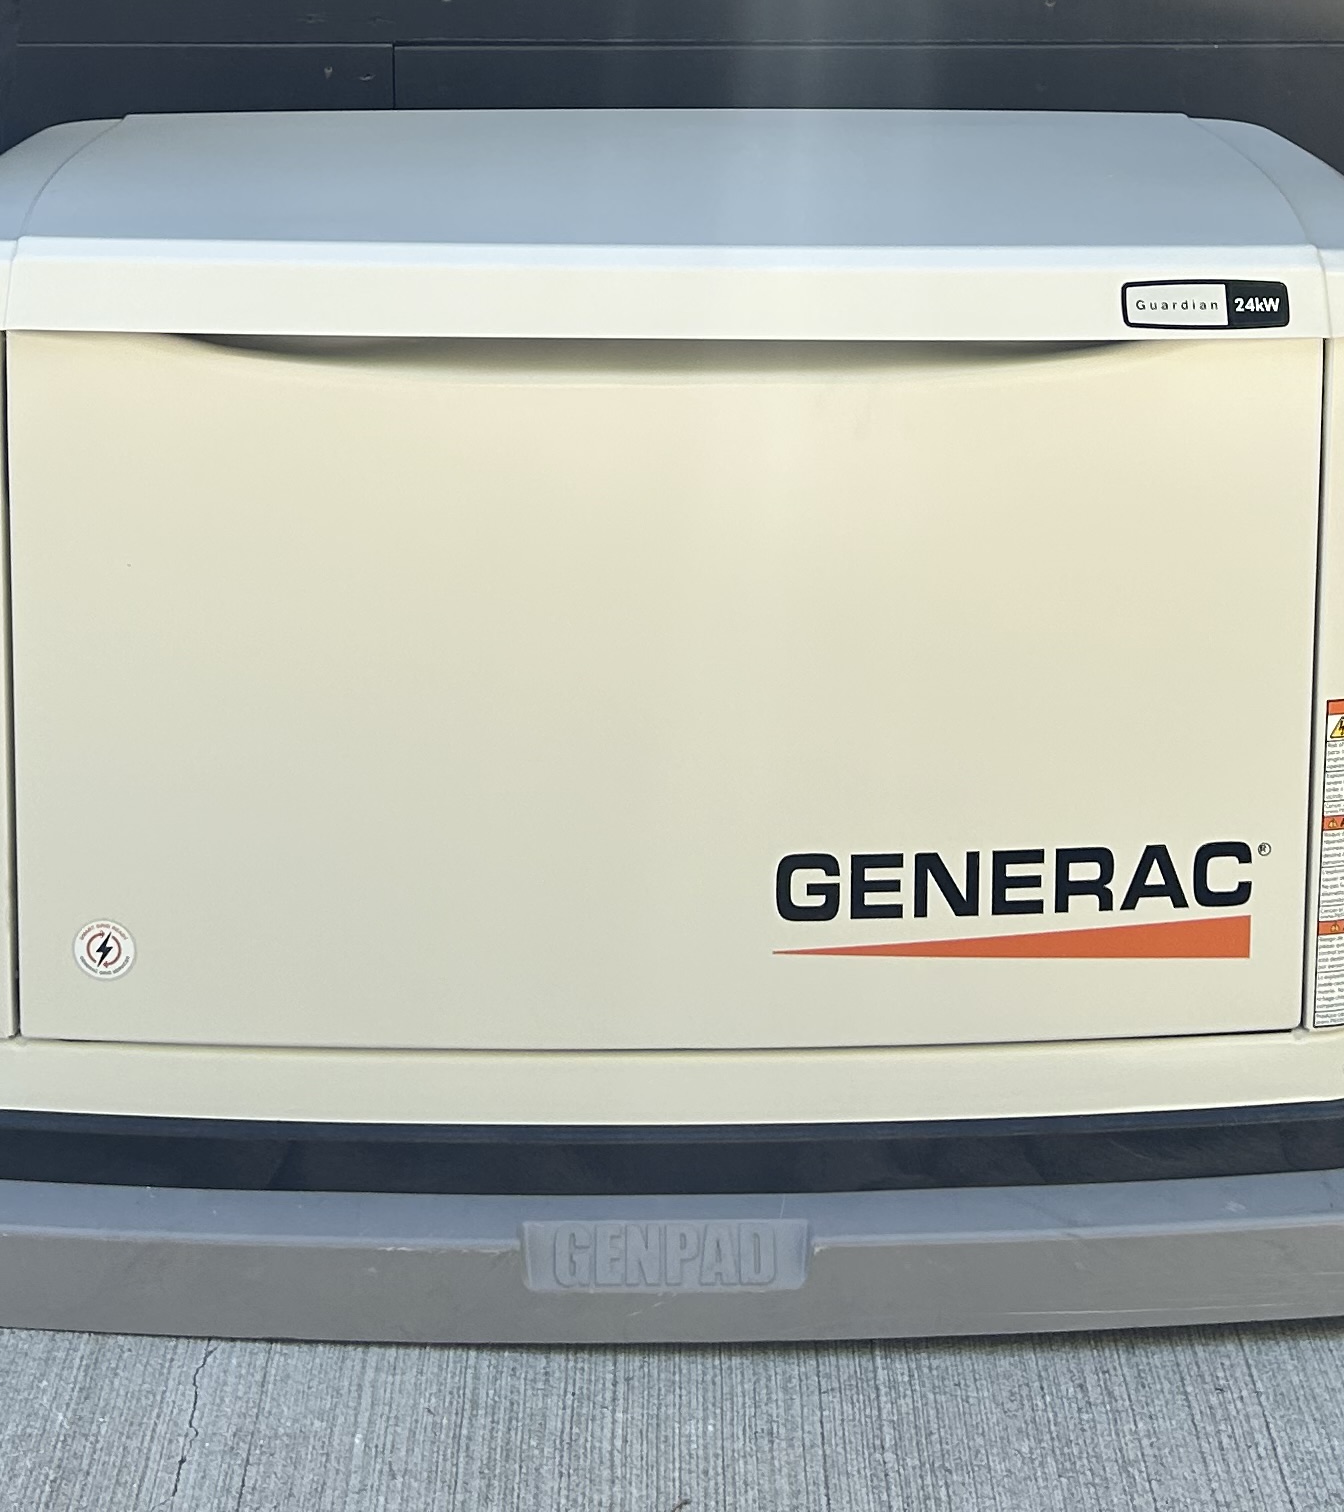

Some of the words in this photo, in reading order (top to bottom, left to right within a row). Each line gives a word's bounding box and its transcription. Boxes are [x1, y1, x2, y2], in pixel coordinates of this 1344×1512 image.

[1135, 299, 1219, 311] Guardian
[1234, 296, 1280, 312] 24kW
[775, 840, 1254, 922] GENERAC
[553, 1222, 777, 1288] GENPAD
